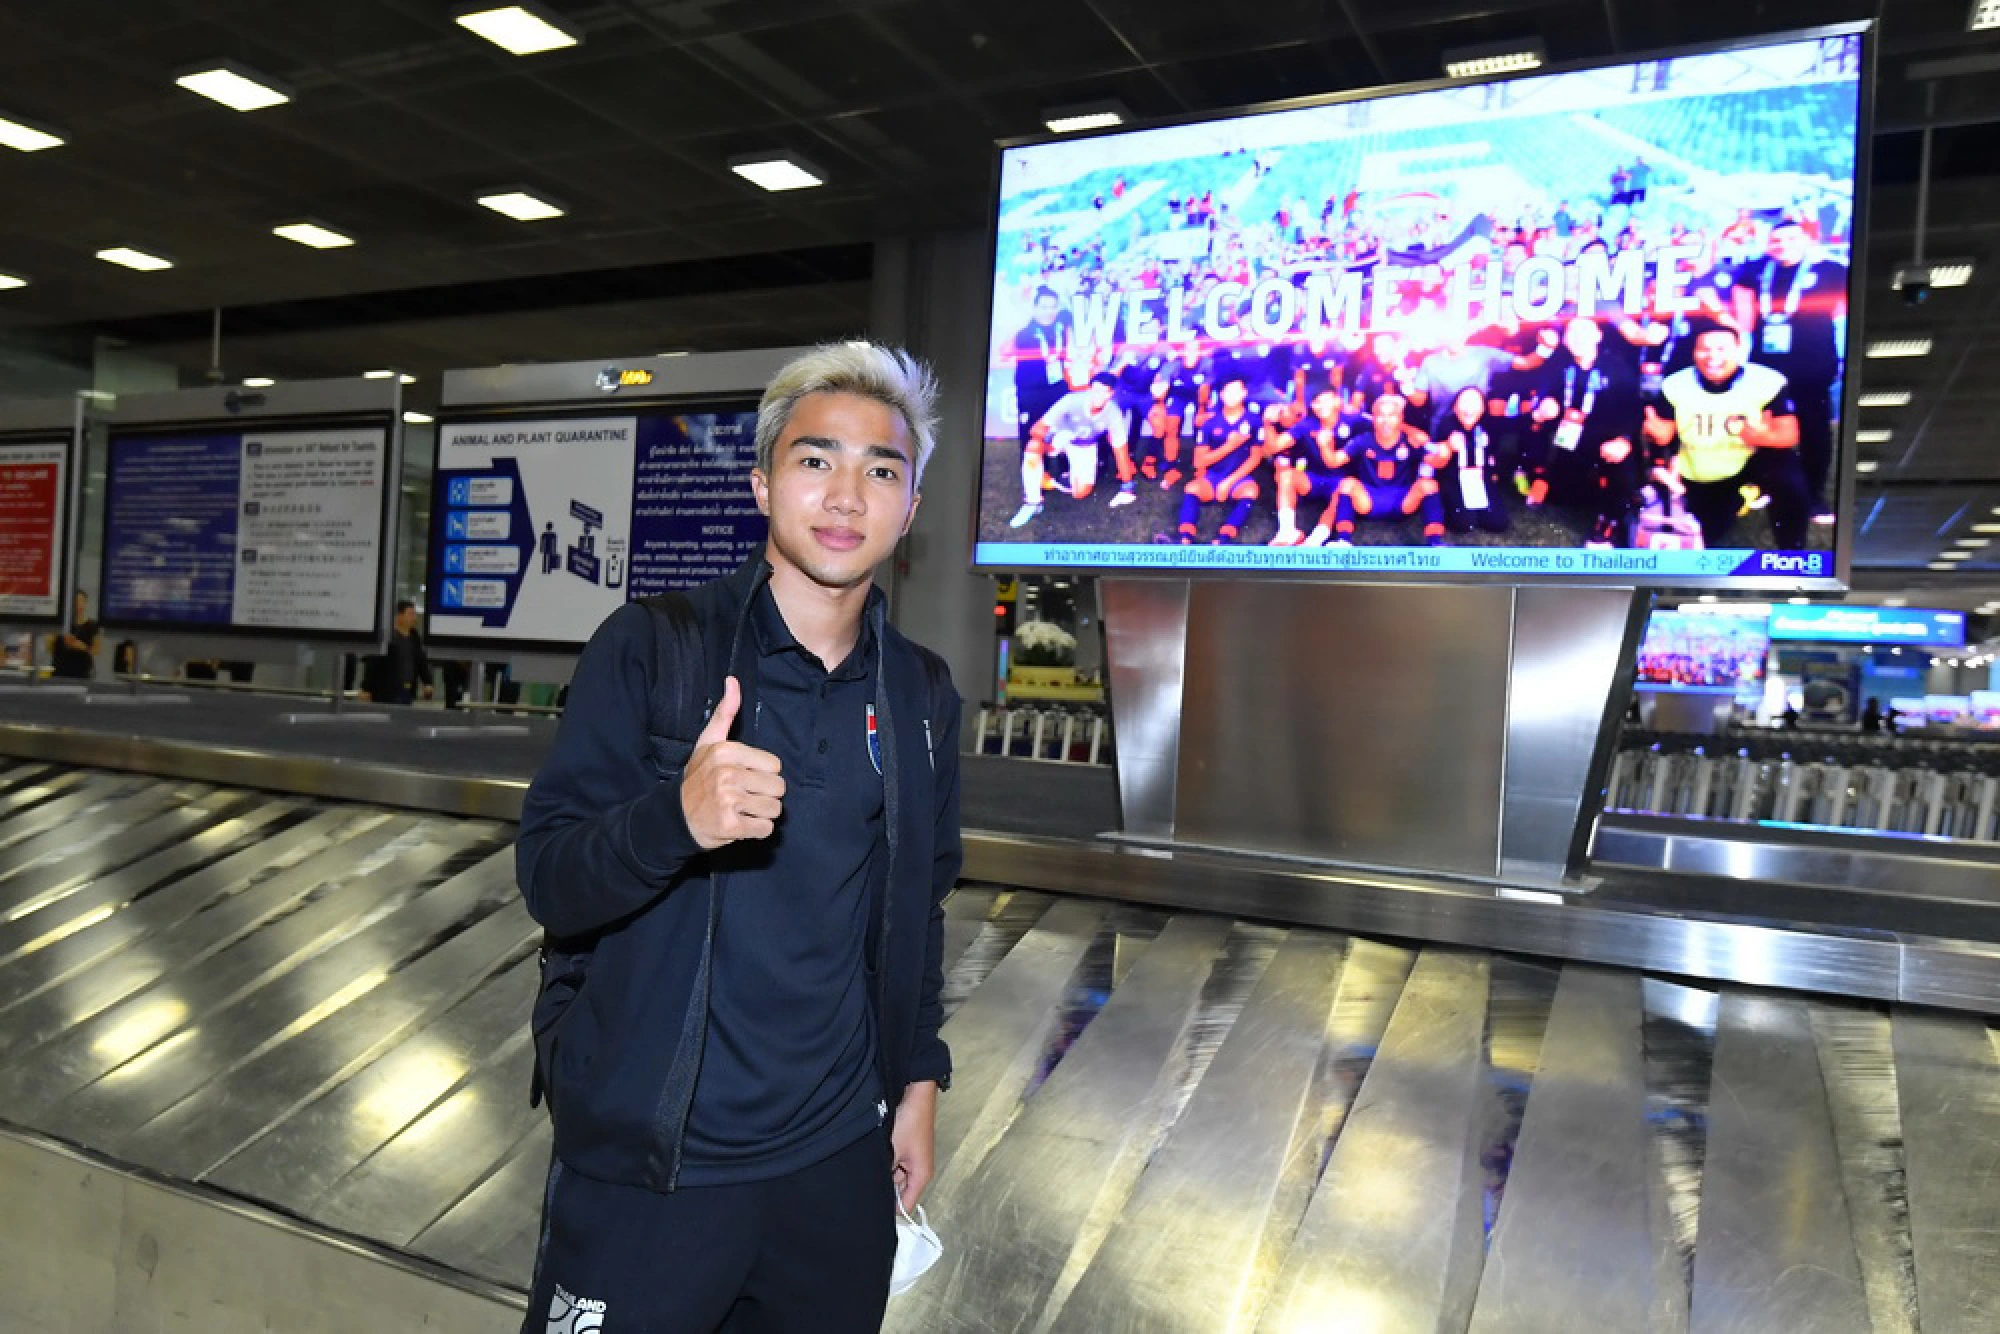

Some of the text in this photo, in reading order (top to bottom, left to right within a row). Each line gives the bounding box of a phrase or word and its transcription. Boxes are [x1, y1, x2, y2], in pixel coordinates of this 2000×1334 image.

[1072, 246, 1703, 348] WELCOME HOME
[452, 428, 628, 447] ANIMAL AND PLANT QUARANTINE
[702, 525, 734, 535] NOTICE
[1471, 552, 1657, 571] Welcome to Thailand
